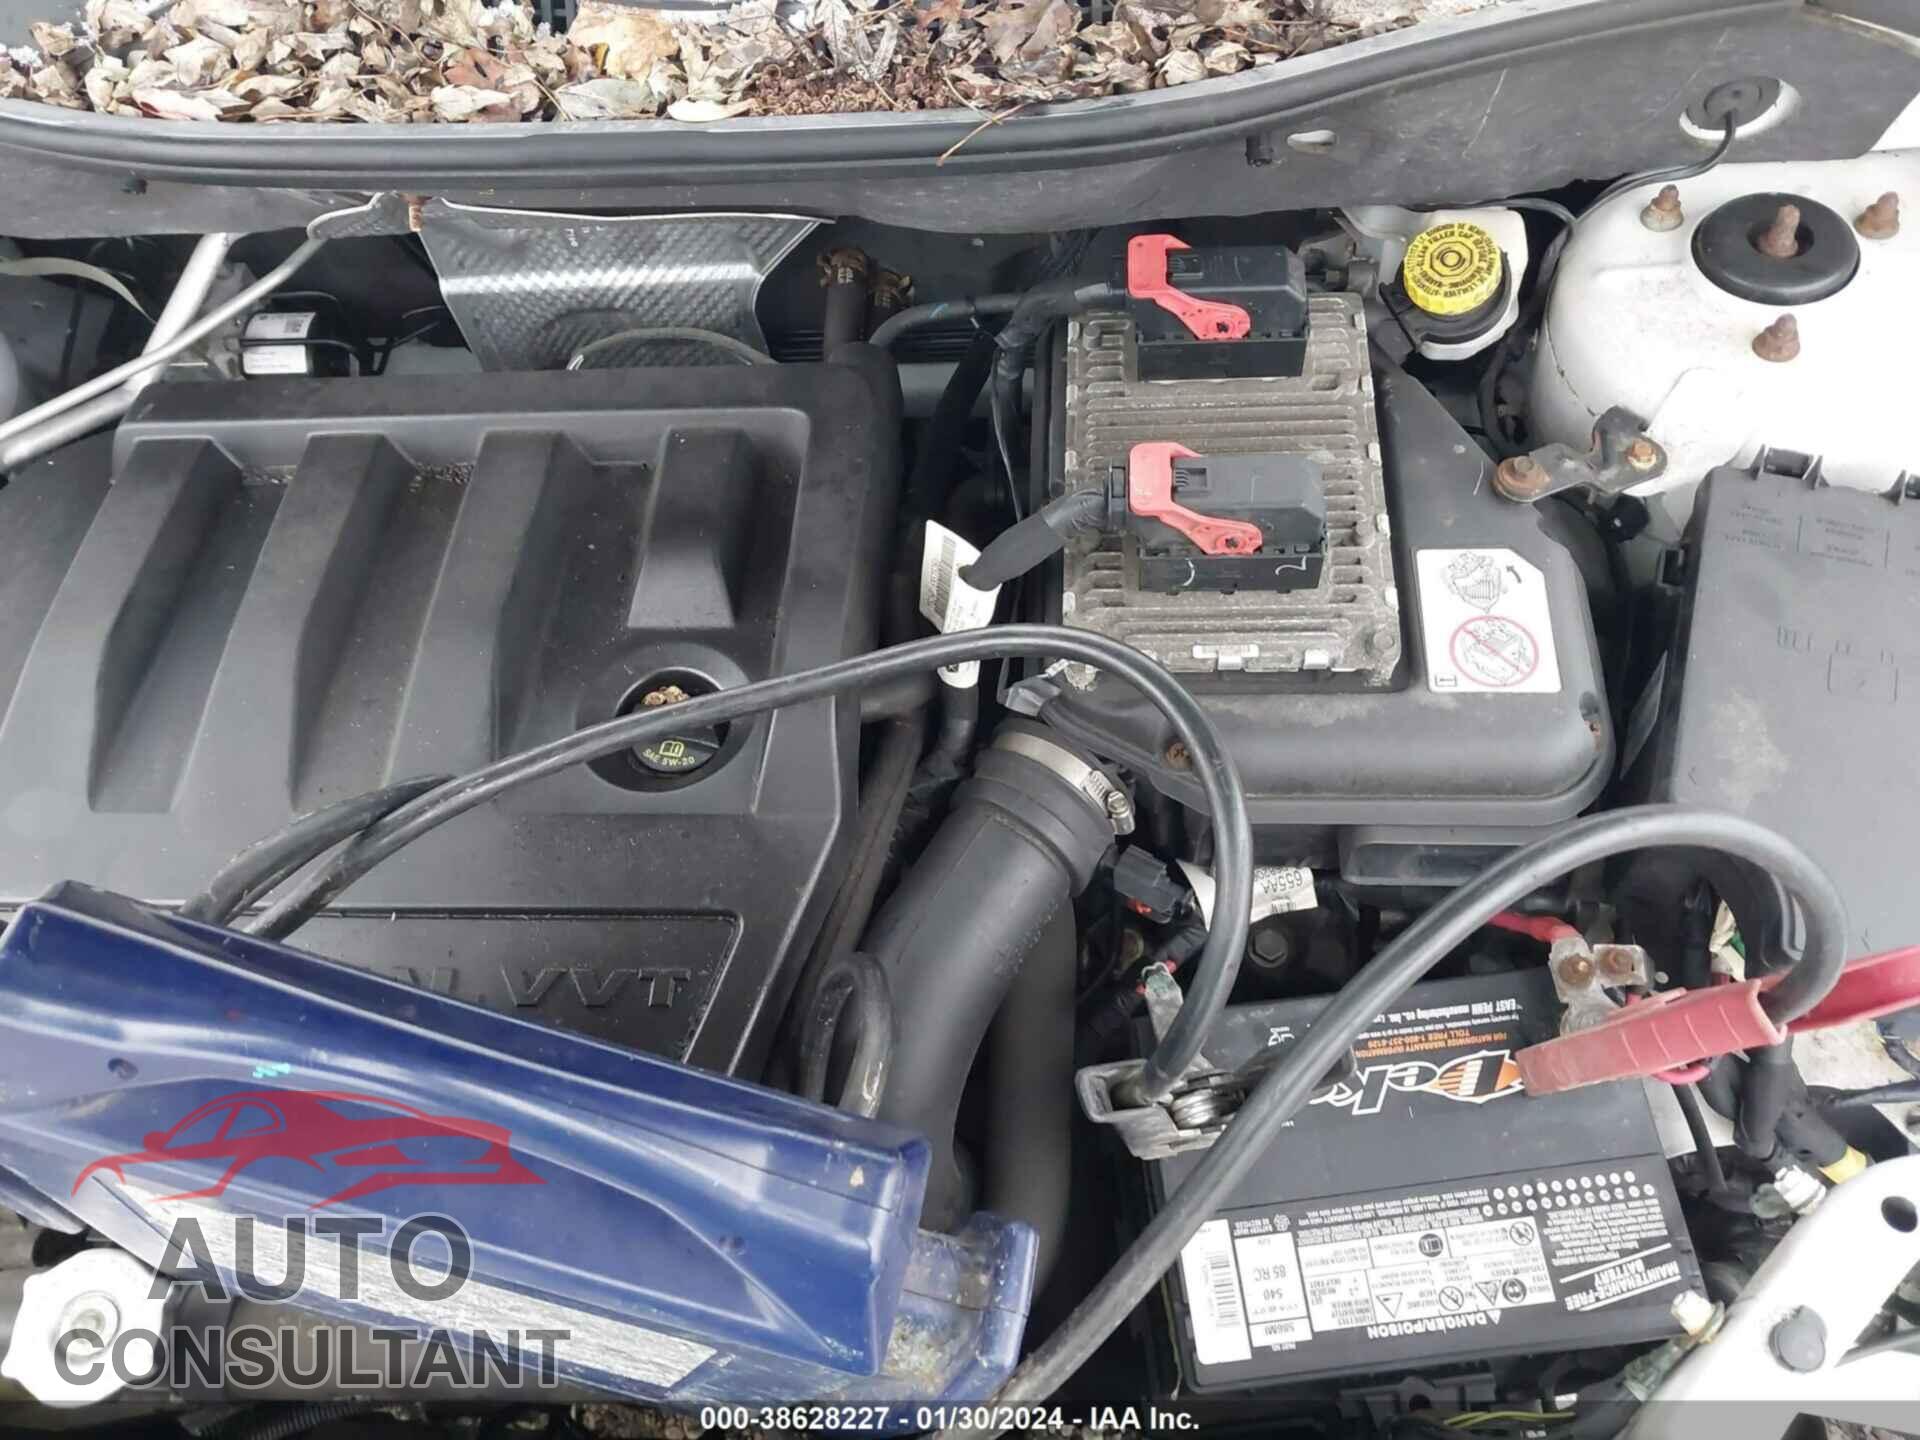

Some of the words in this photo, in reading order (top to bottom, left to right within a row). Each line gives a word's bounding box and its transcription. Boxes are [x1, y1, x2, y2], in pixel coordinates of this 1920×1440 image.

[642, 748, 661, 763] SAE
[499, 967, 692, 1008] VVT
[1494, 997, 1516, 1011] EAST
[1448, 1028, 1470, 1039] TOLL
[1253, 1266, 1272, 1282] RC
[1273, 1264, 1287, 1280] 85
[1263, 1288, 1283, 1301] 540
[1368, 1315, 1487, 1340] DANGER/POISON
